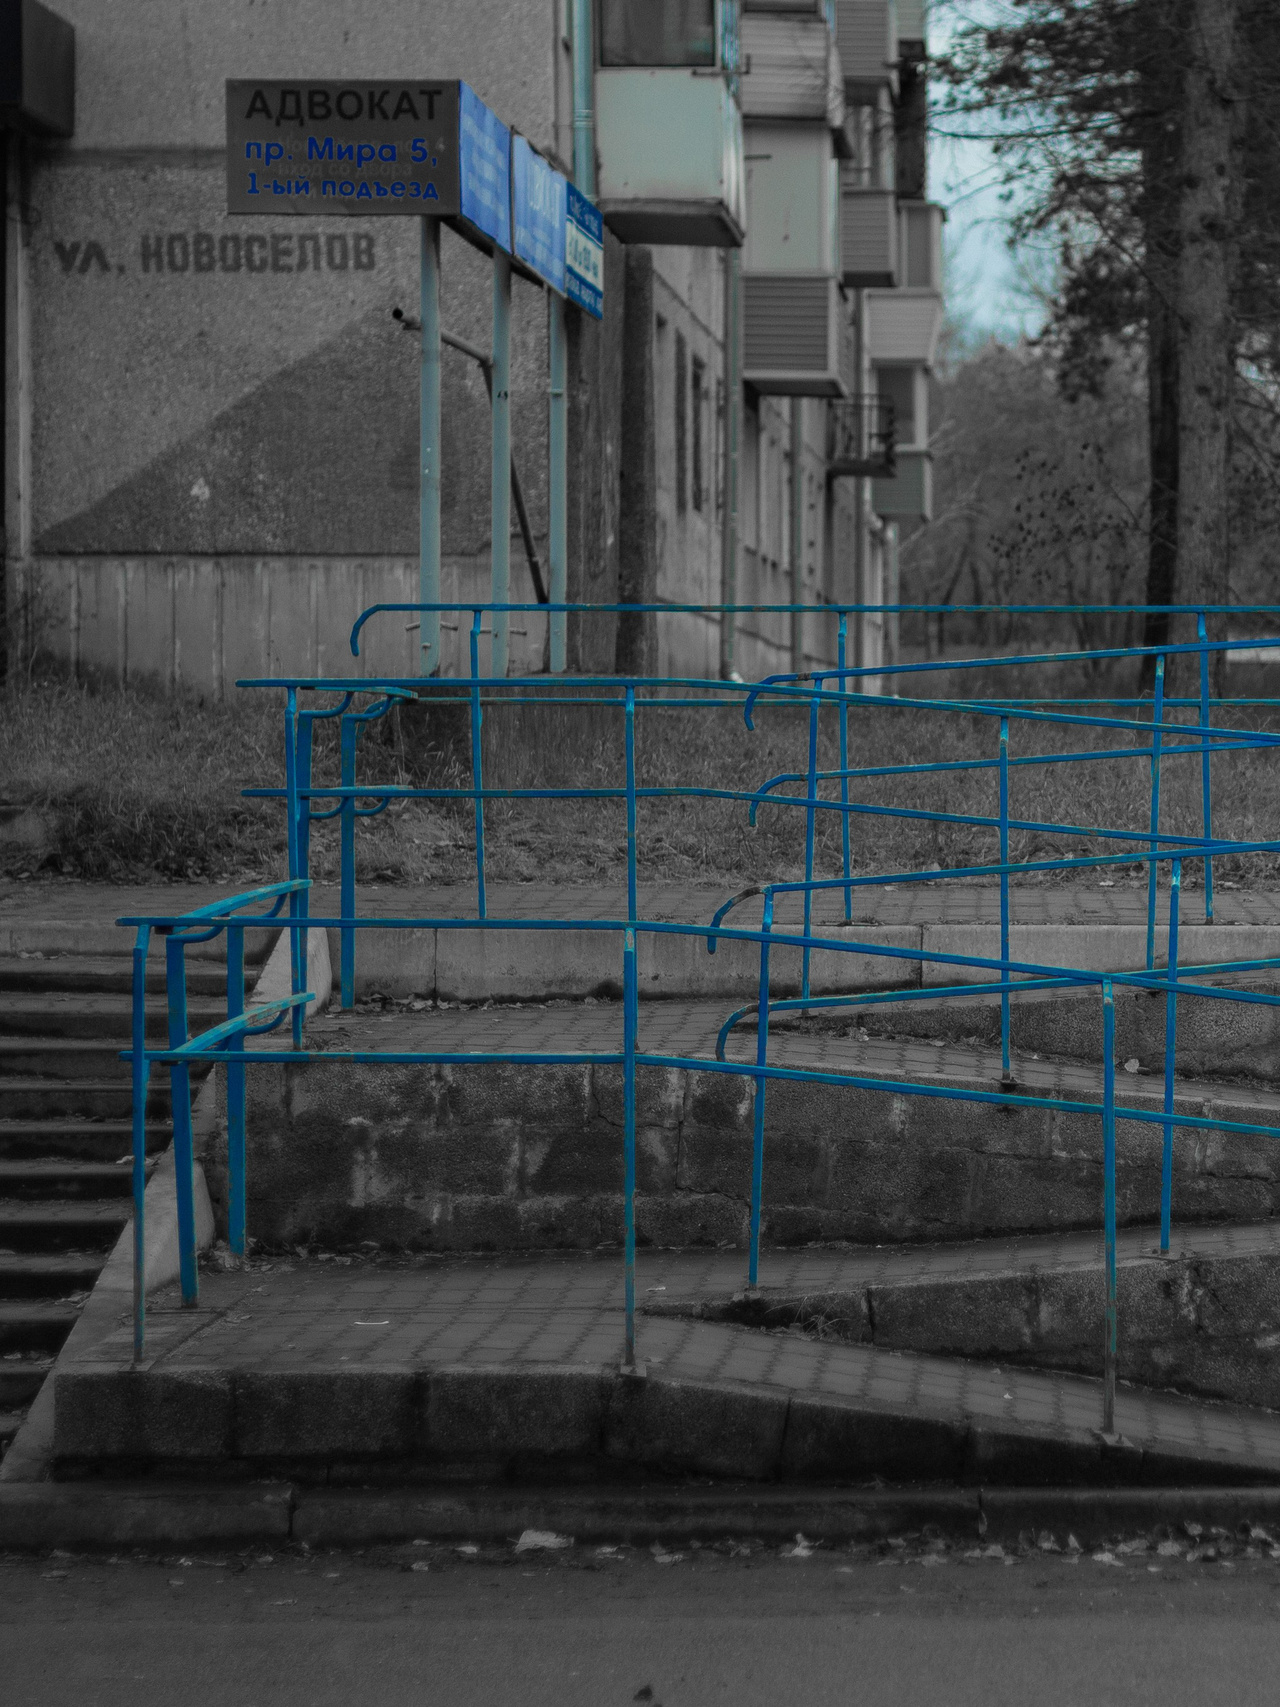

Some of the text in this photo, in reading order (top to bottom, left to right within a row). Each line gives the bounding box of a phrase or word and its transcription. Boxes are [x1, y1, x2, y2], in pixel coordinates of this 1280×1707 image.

[245, 89, 442, 126] АДВОКАТ
[245, 136, 437, 168] пр. Мира 5,
[247, 172, 439, 200] 1-ый подъезд
[141, 232, 376, 273] НОВОСЕЛОВ
